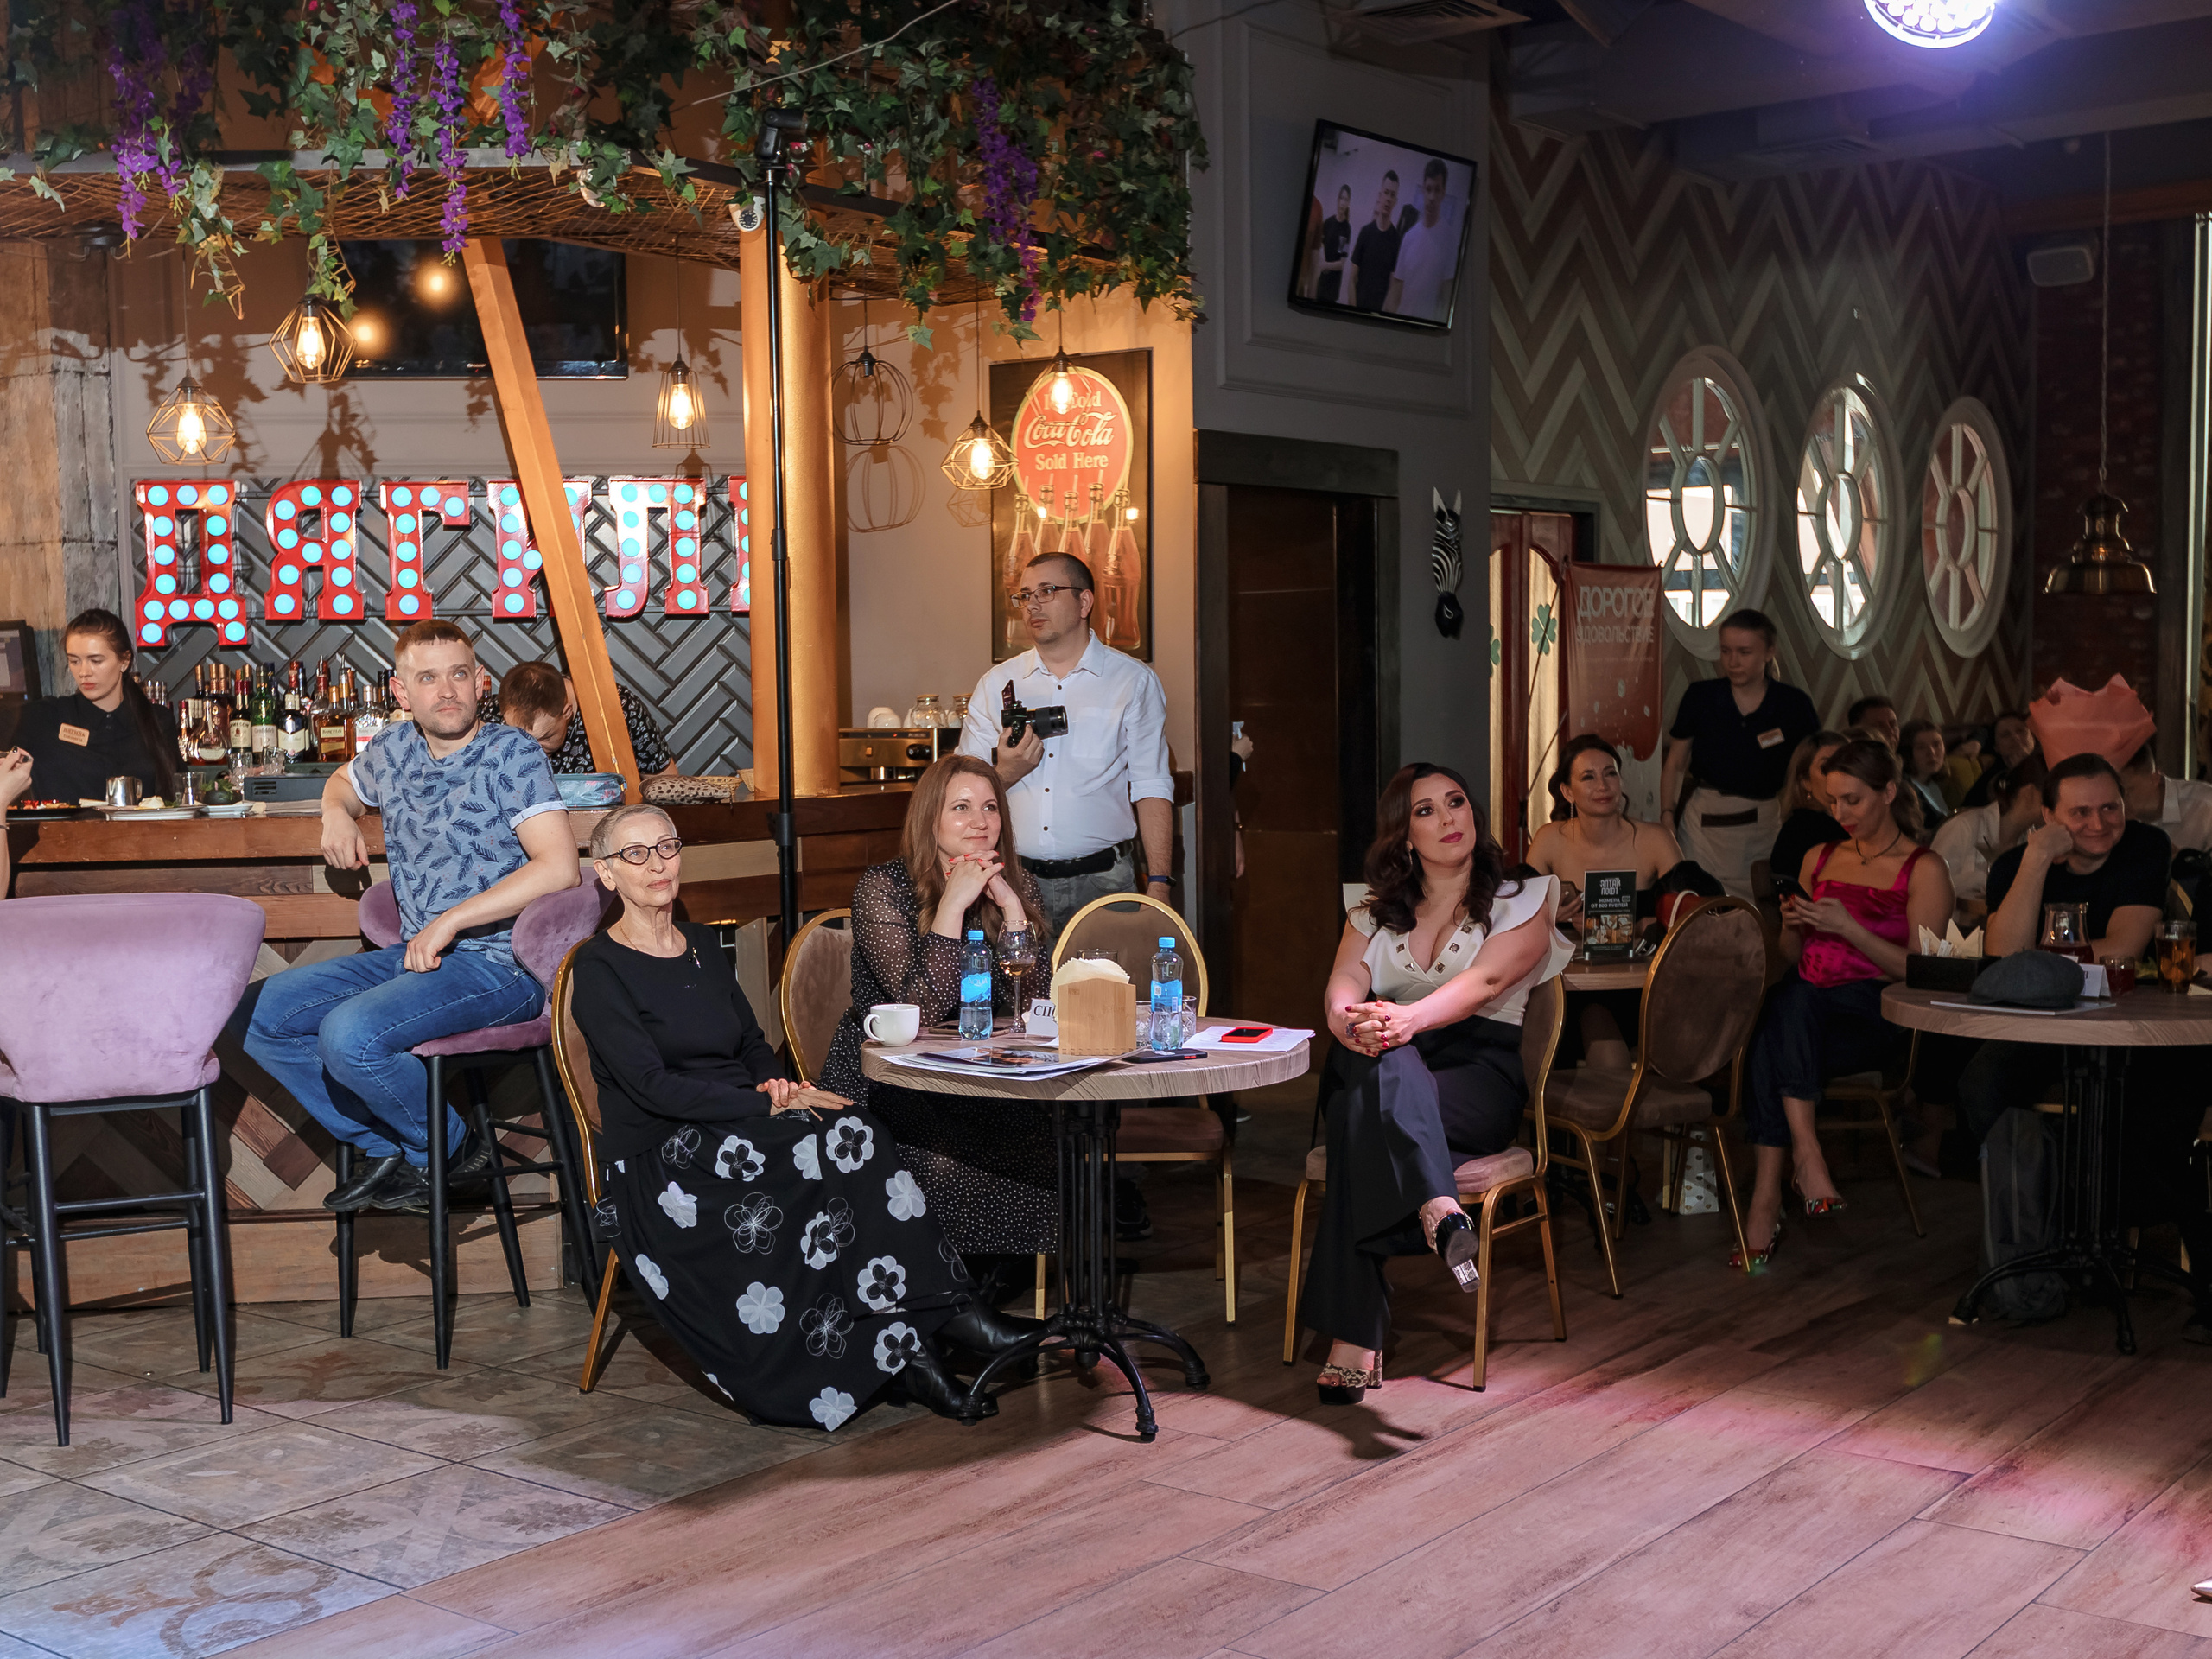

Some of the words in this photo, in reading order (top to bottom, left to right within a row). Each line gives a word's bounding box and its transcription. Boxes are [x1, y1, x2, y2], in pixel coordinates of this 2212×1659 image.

[1034, 452, 1068, 472] Sold
[1071, 451, 1109, 470] Here
[135, 476, 750, 647] ДЯГИЛ
[1577, 585, 1655, 623] ДОРОГОЕ
[1576, 625, 1655, 646] УДОВОЛЬСТВИЕ
[1033, 1004, 1056, 1018] СП
